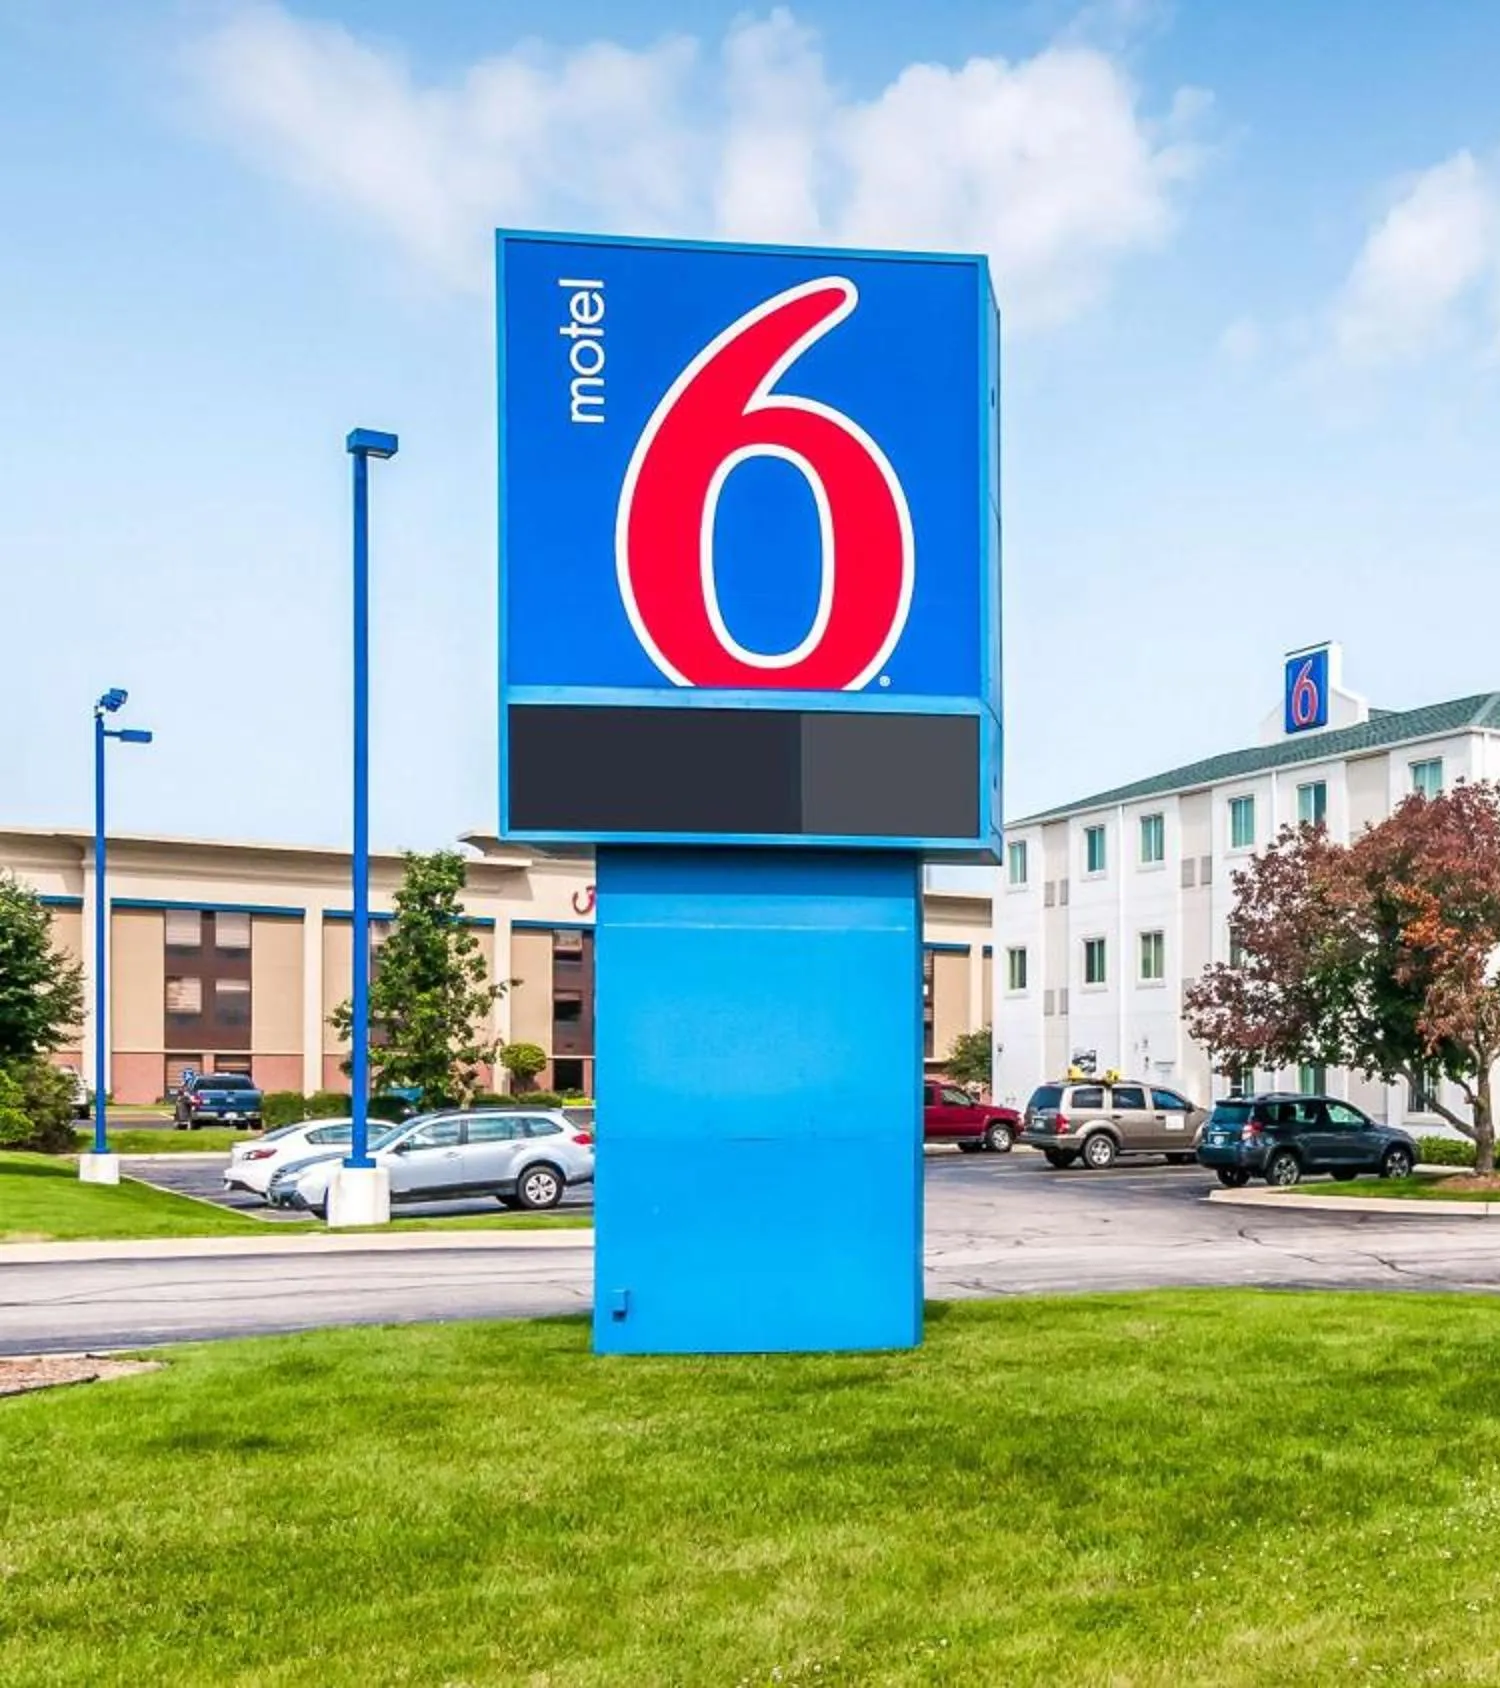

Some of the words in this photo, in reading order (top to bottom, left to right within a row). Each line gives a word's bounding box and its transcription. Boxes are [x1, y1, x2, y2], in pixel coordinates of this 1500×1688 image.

[558, 278, 605, 423] motel
[615, 275, 915, 691] 6
[1291, 659, 1319, 727] 6
